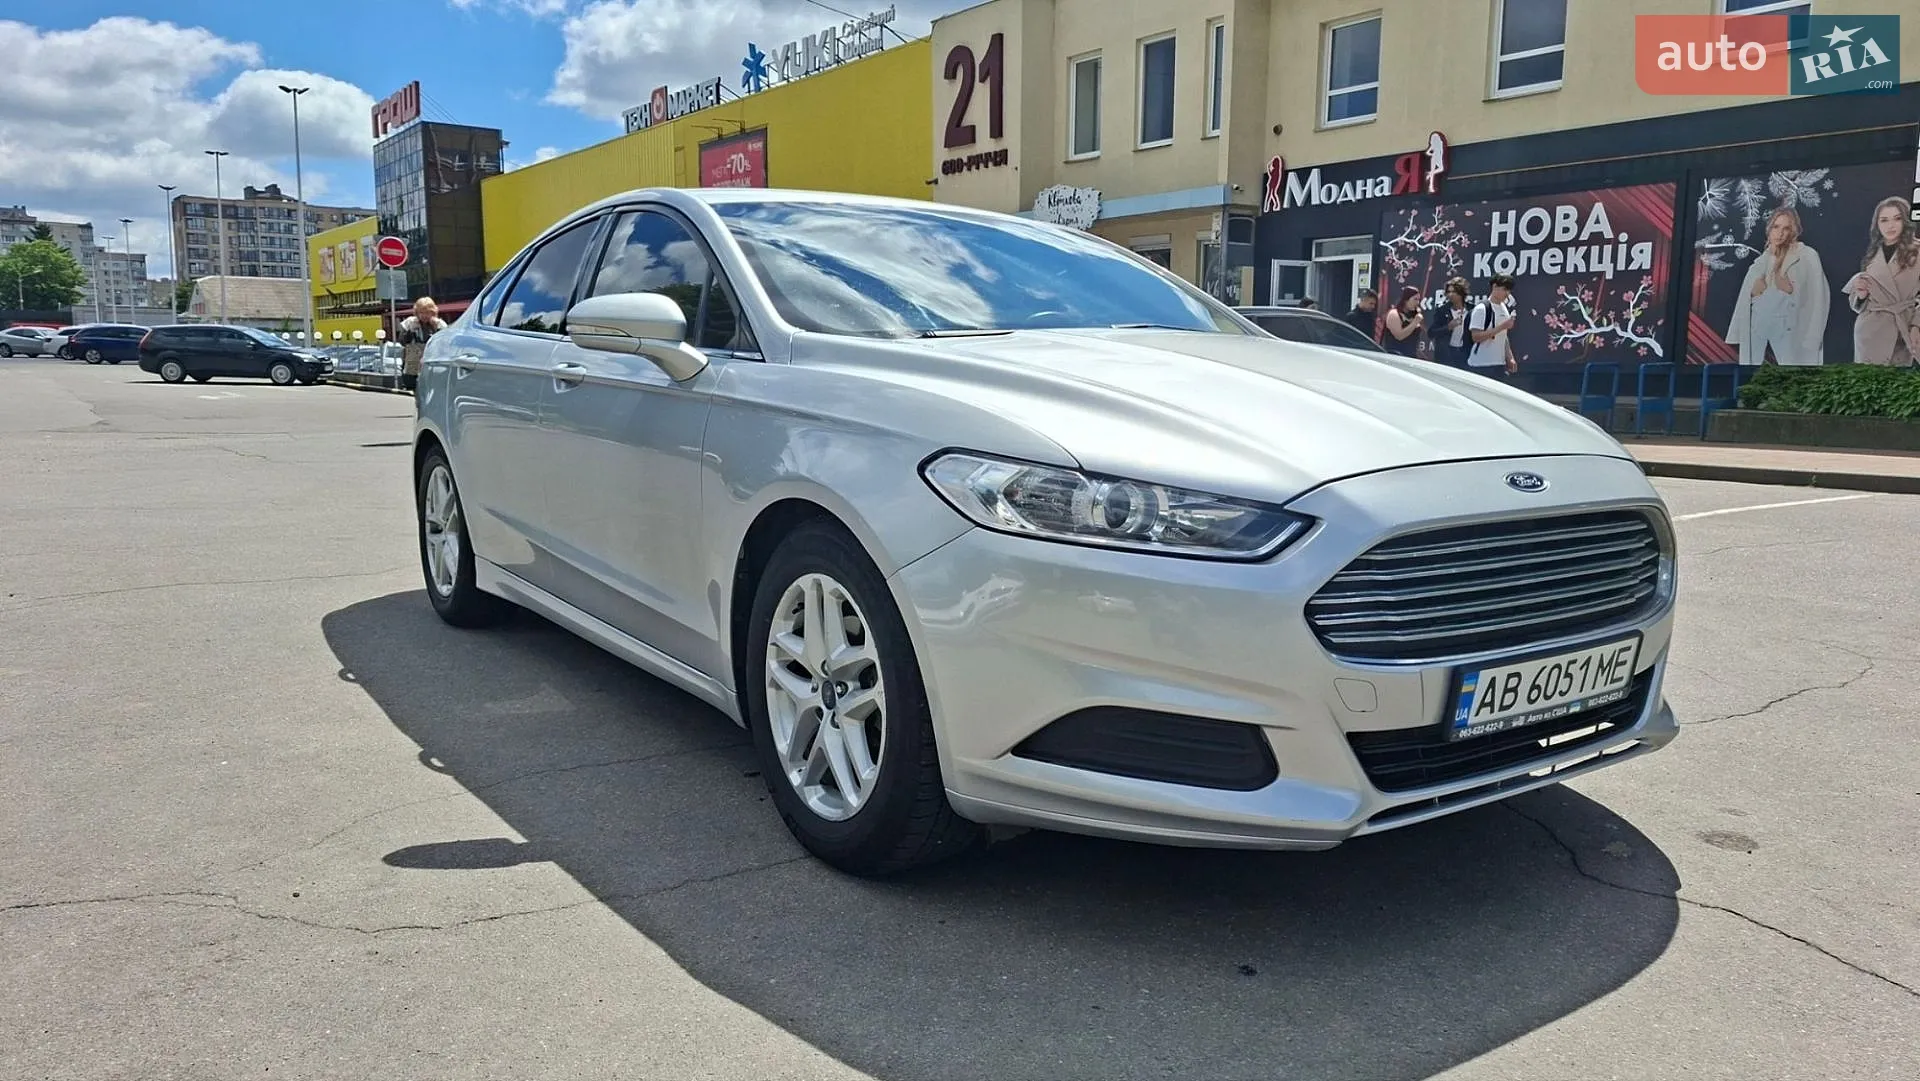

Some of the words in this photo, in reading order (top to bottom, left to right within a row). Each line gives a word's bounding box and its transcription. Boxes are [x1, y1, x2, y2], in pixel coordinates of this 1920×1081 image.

[772, 26, 836, 82] YUKI
[371, 80, 420, 138] ГРОШ
[944, 33, 1004, 148] 21
[1490, 202, 1614, 247] НОВА
[1473, 232, 1652, 280] колекція
[1474, 672, 1522, 717] AB
[1526, 655, 1591, 705] 6051
[1591, 646, 1632, 690] ME
[1455, 708, 1468, 721] UA
[1552, 706, 1568, 717] США
